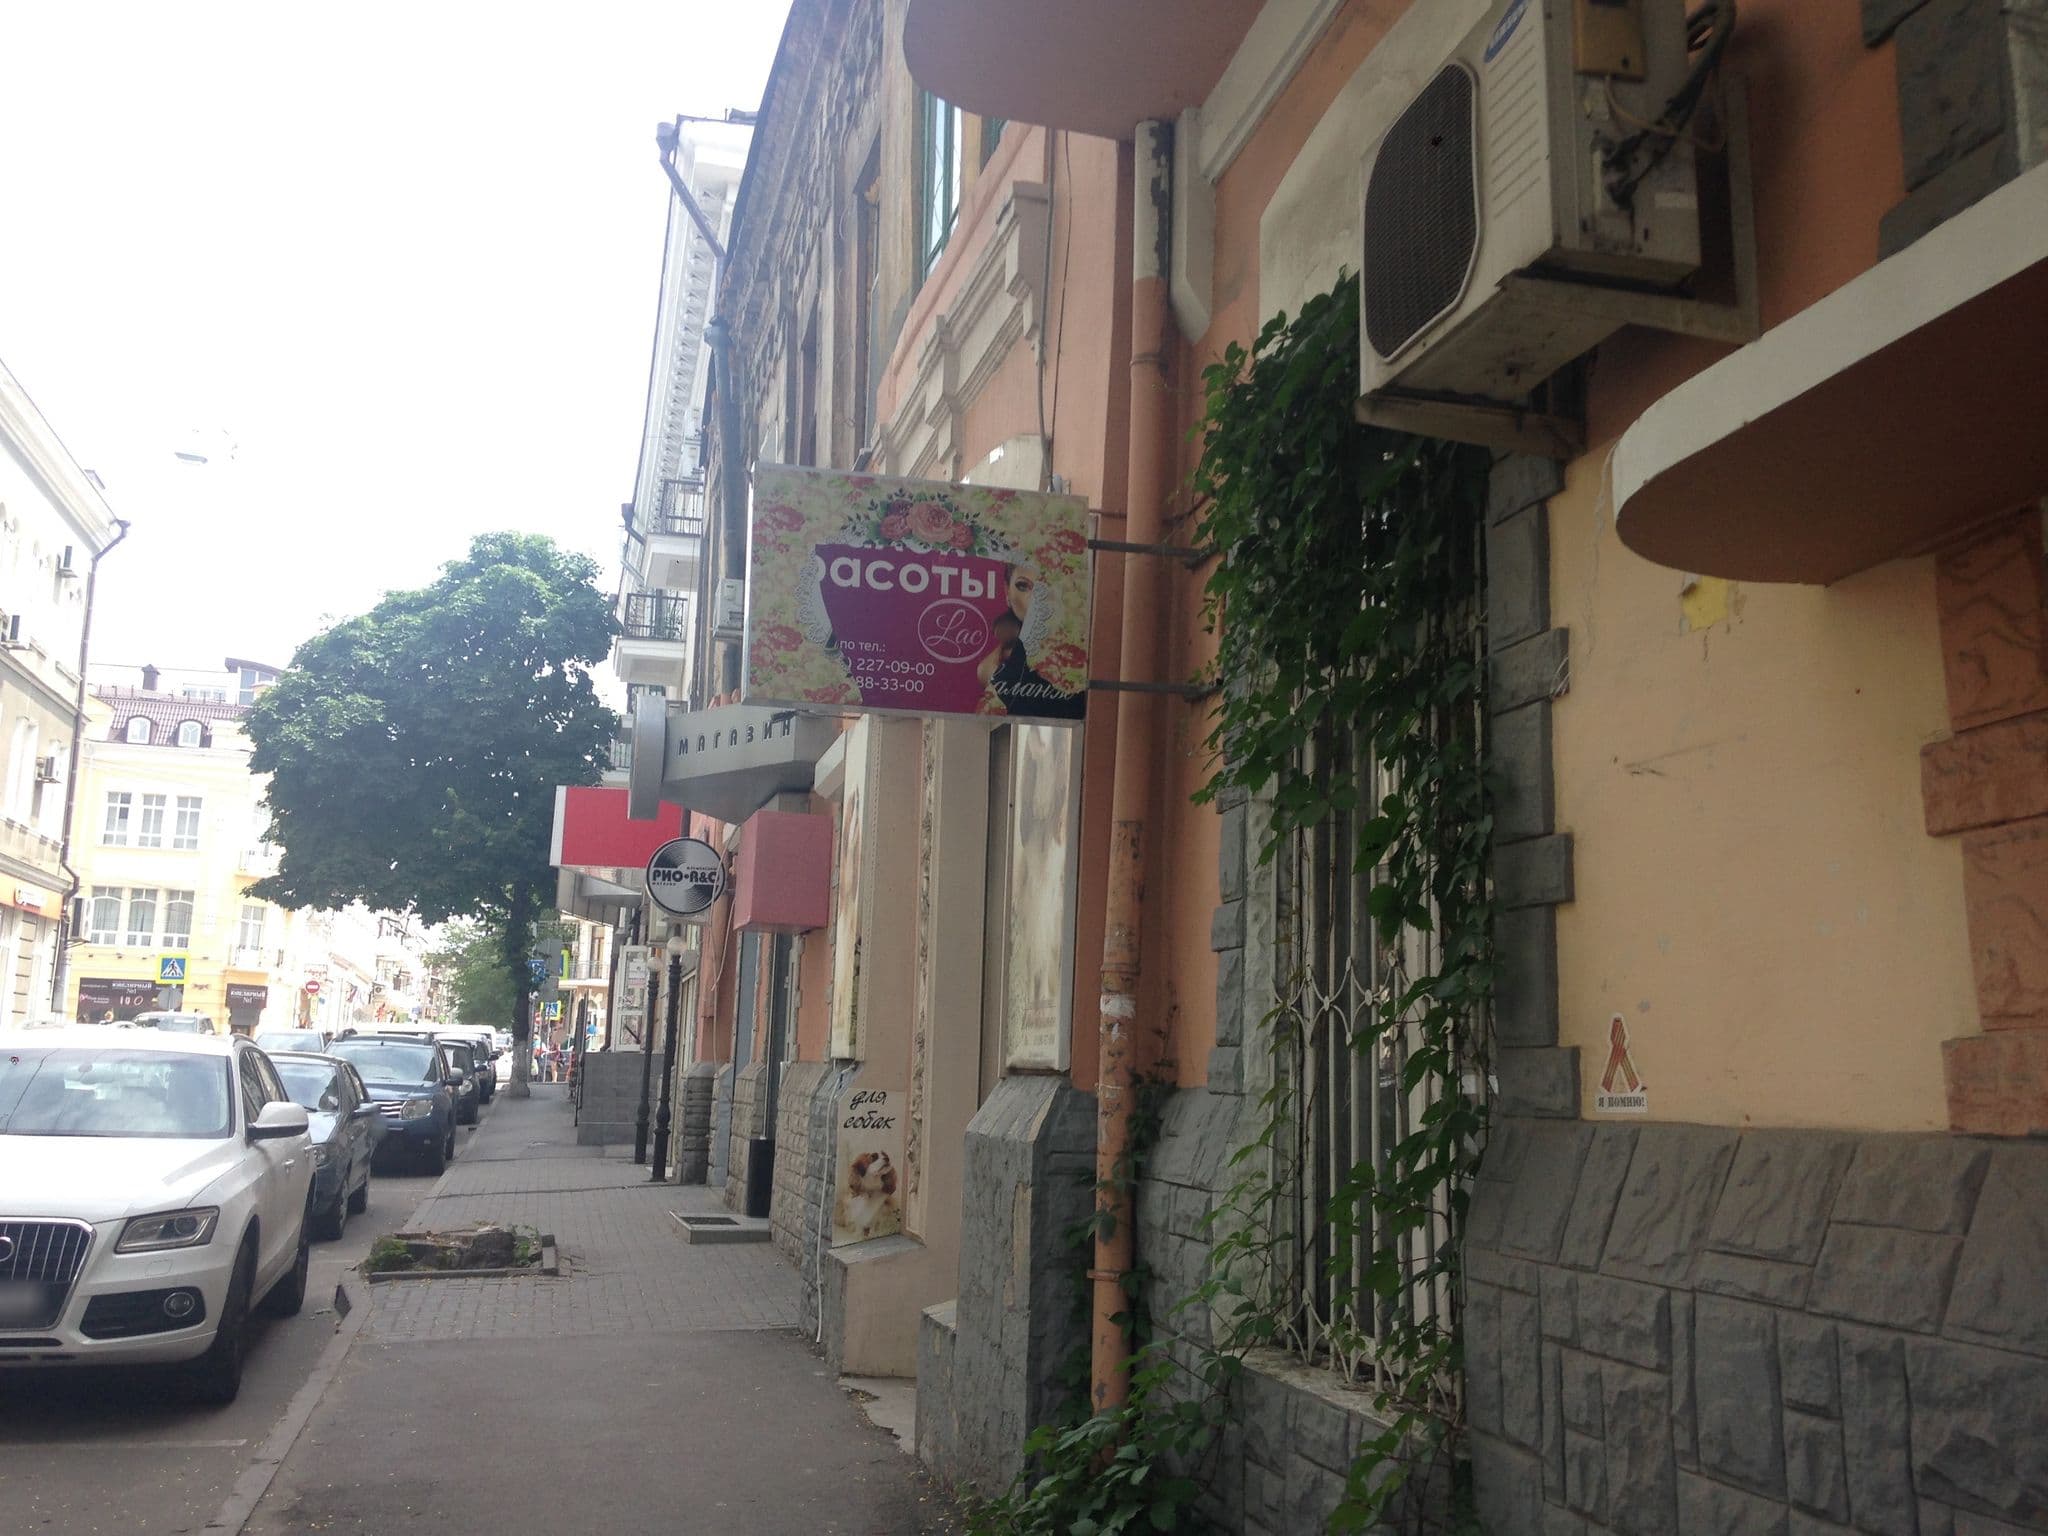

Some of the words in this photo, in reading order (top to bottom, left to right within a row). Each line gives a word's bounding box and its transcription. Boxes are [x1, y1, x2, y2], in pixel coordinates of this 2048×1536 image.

[839, 640, 856, 650] по
[856, 658, 935, 675] 227-09-00
[679, 719, 790, 755] МАГАЗИН
[850, 1090, 887, 1110] для
[843, 1110, 896, 1129] собак
